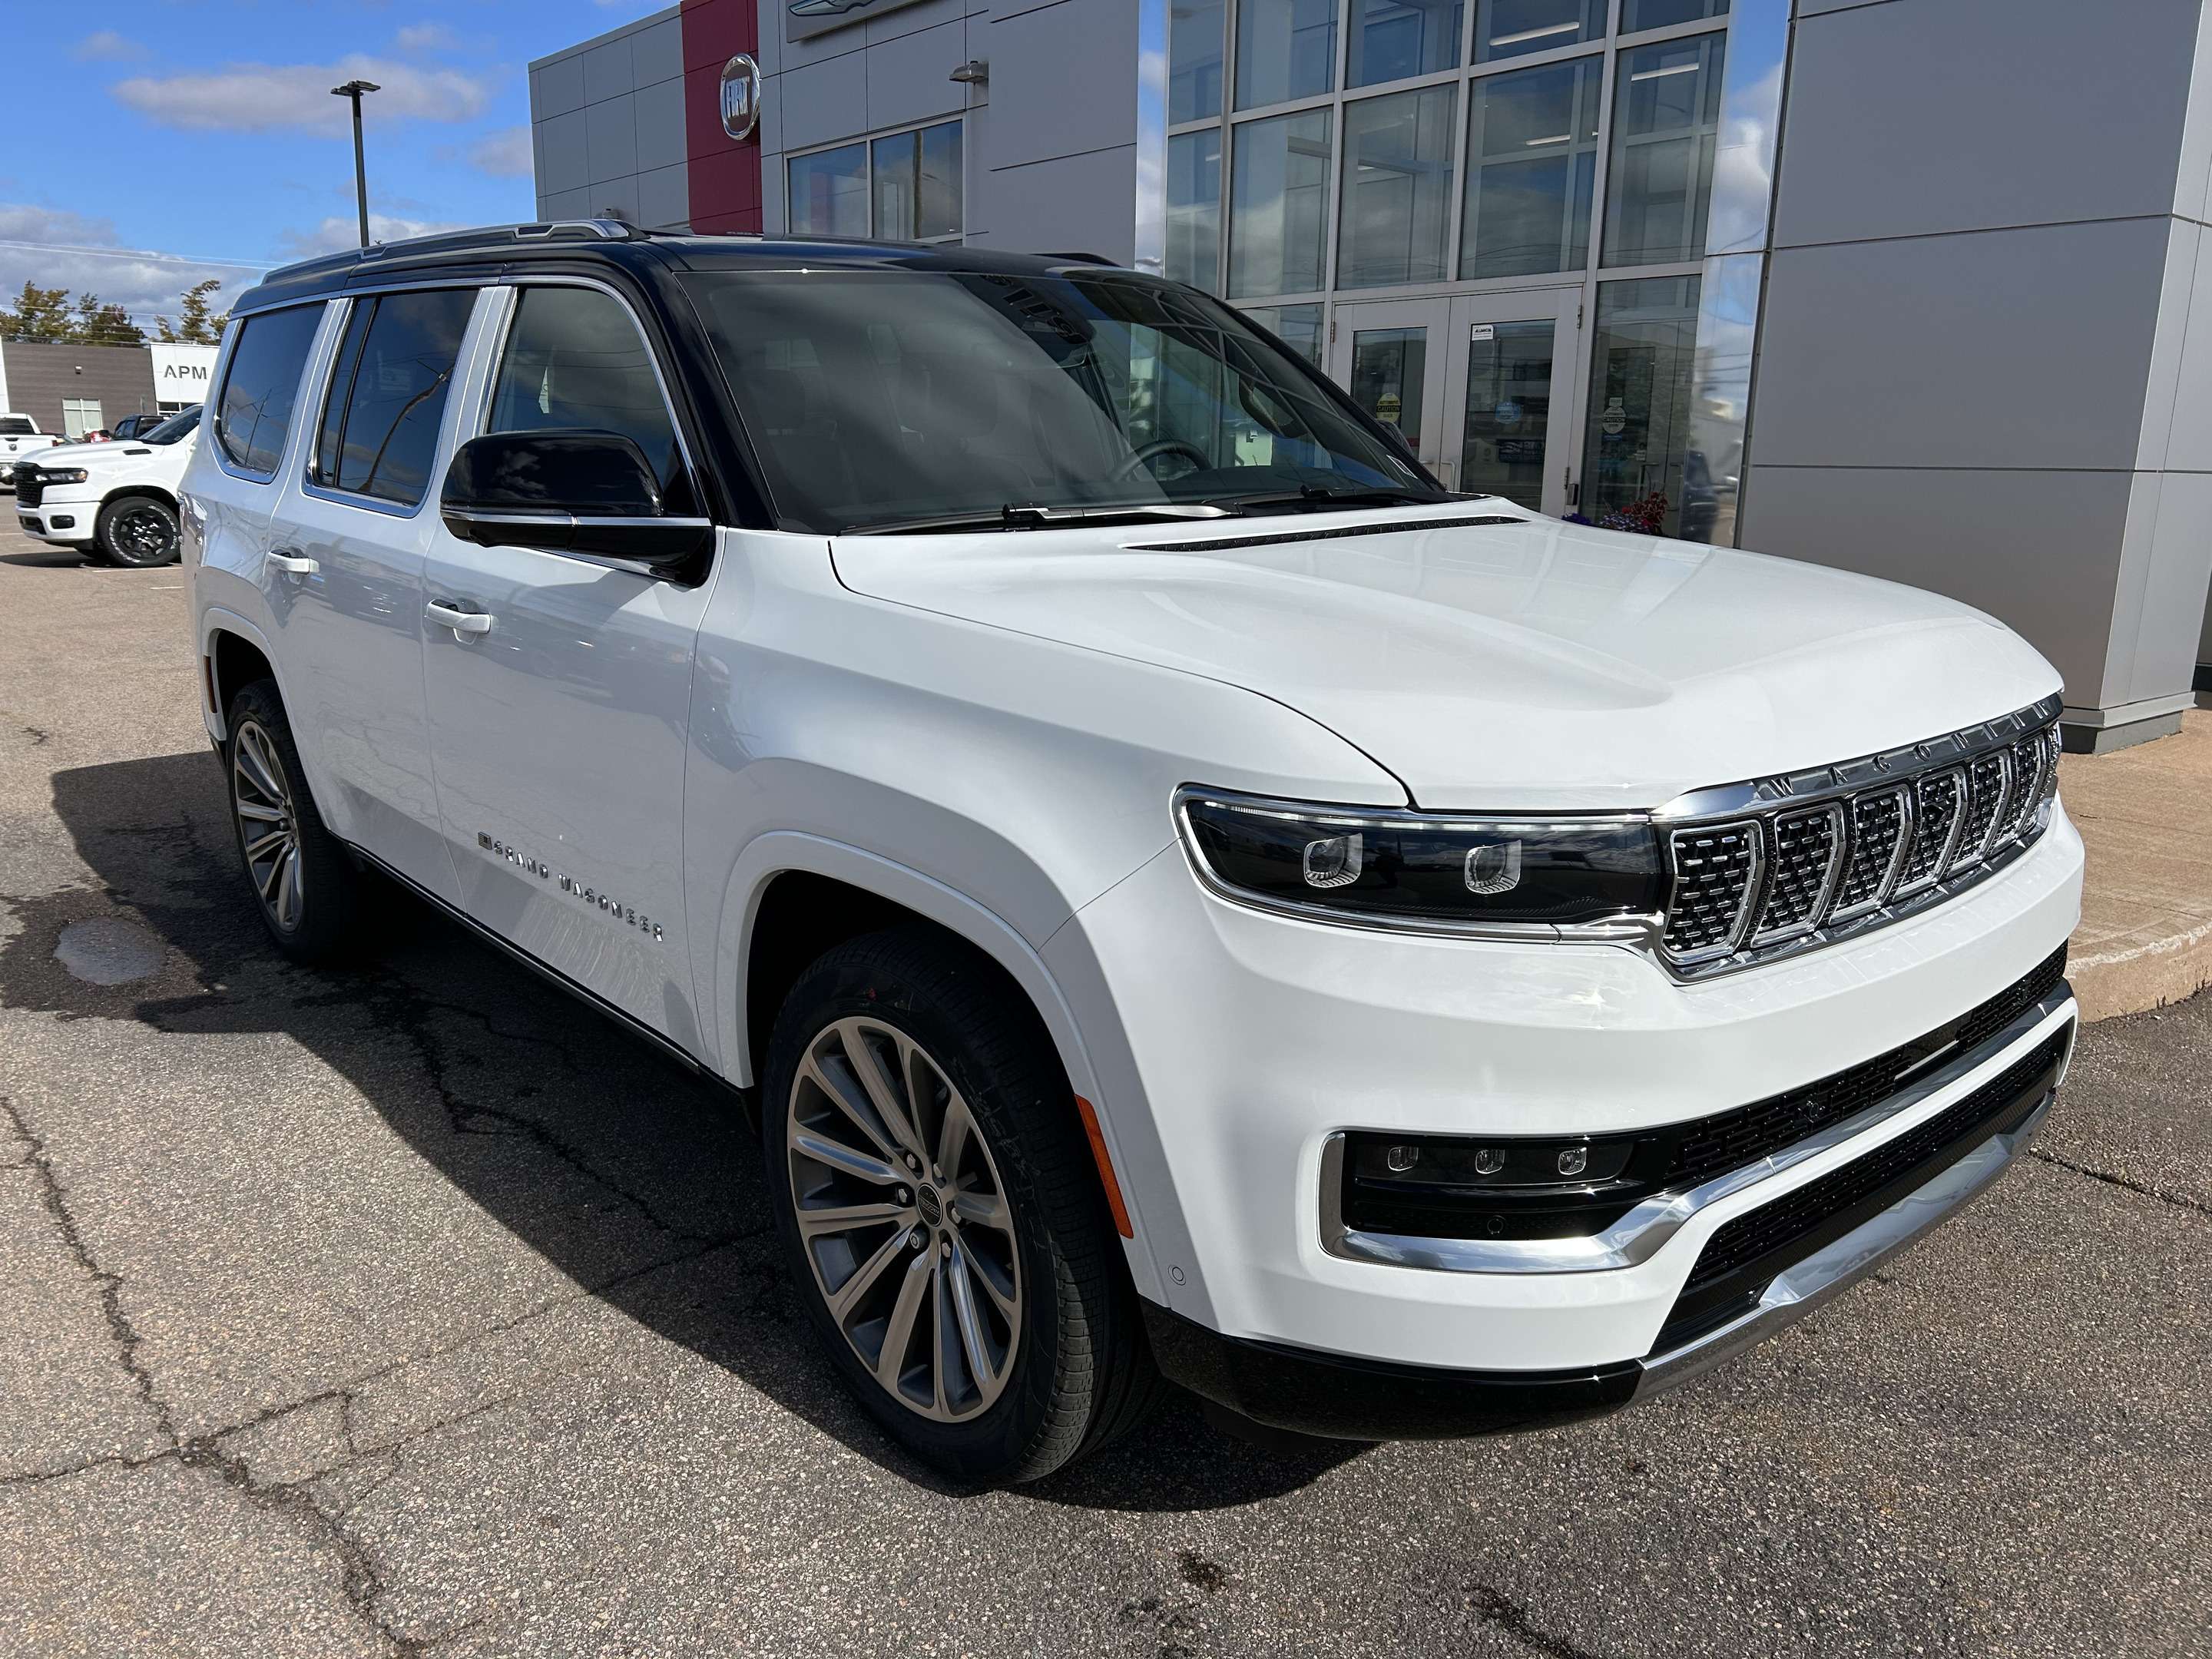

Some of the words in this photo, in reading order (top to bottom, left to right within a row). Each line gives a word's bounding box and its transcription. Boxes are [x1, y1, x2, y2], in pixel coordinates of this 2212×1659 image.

[726, 76, 750, 118] FIAT
[164, 364, 207, 380] APM
[494, 840, 548, 879] GRAND
[558, 873, 663, 942] WAGONEER
